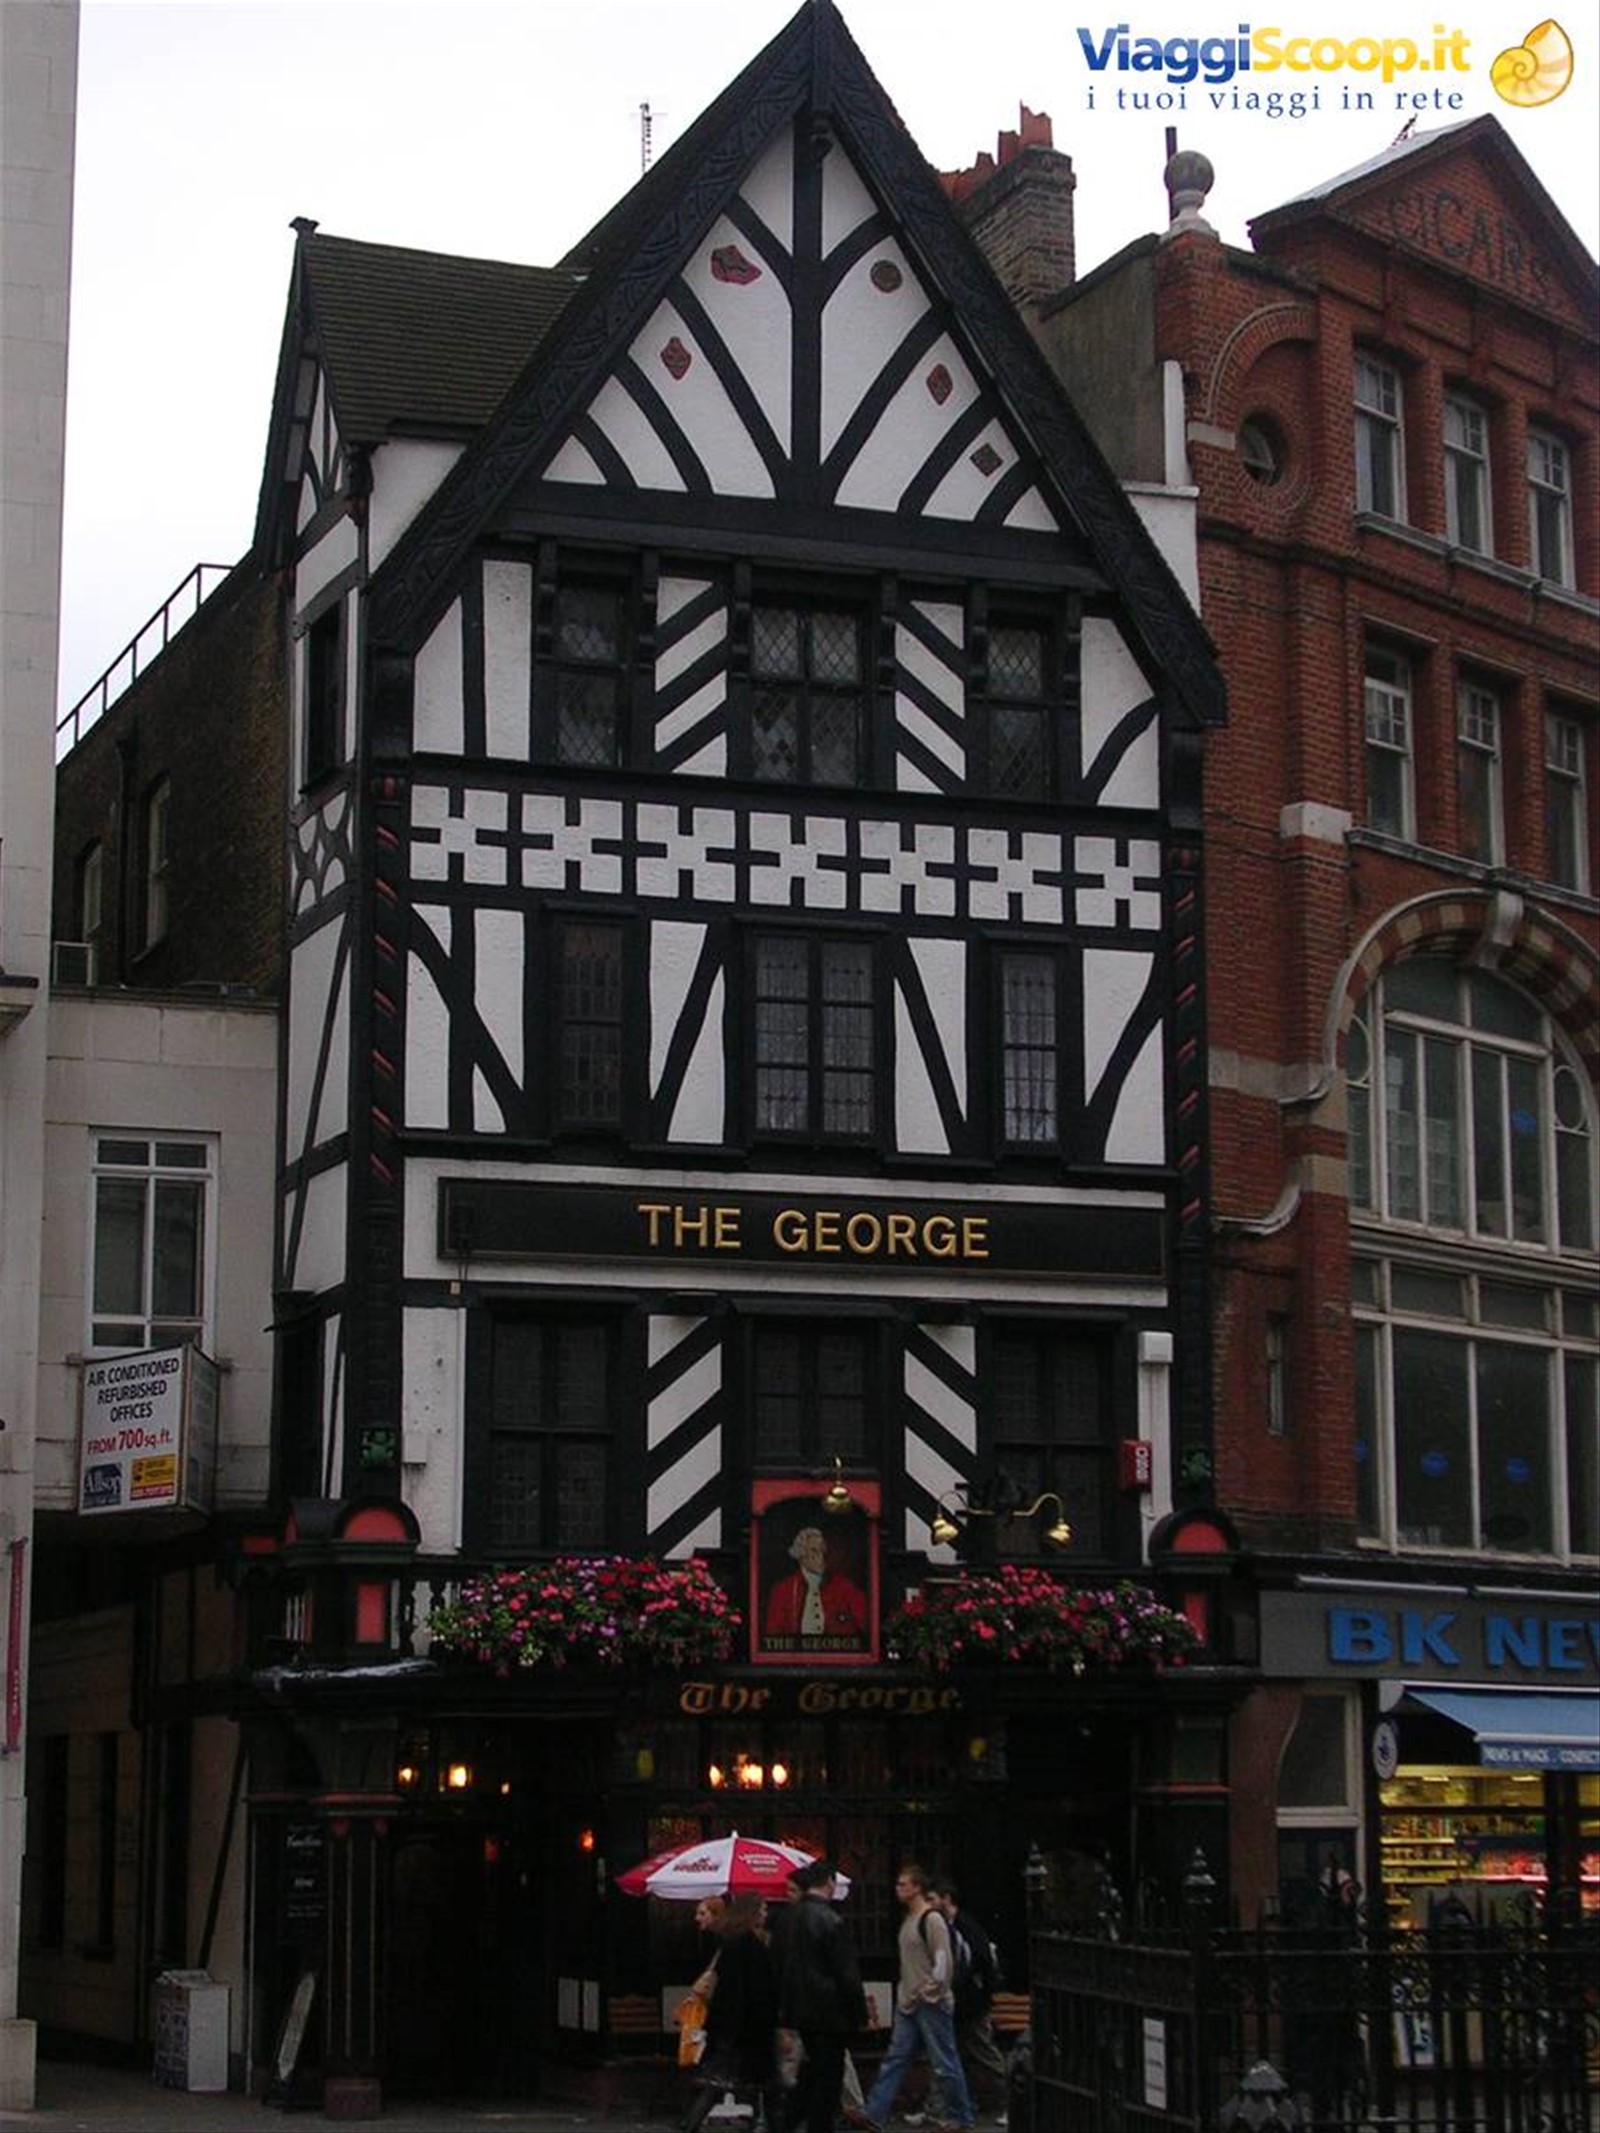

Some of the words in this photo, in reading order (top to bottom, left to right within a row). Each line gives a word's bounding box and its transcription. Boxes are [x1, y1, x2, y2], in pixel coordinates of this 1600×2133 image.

[637, 1203, 742, 1250] THE
[773, 1209, 991, 1258] GEORGE
[87, 1370, 106, 1387] AIR
[108, 1357, 180, 1384] CONDITIONED
[97, 1379, 167, 1406] REFURBISHED
[110, 1401, 154, 1422] OFFICES
[87, 1437, 117, 1455] FROM
[765, 1637, 795, 1650] THE
[801, 1637, 861, 1650] GEORGE
[1327, 1606, 1462, 1666] BK
[1484, 1613, 1600, 1672] NE
[679, 1681, 771, 1715] The
